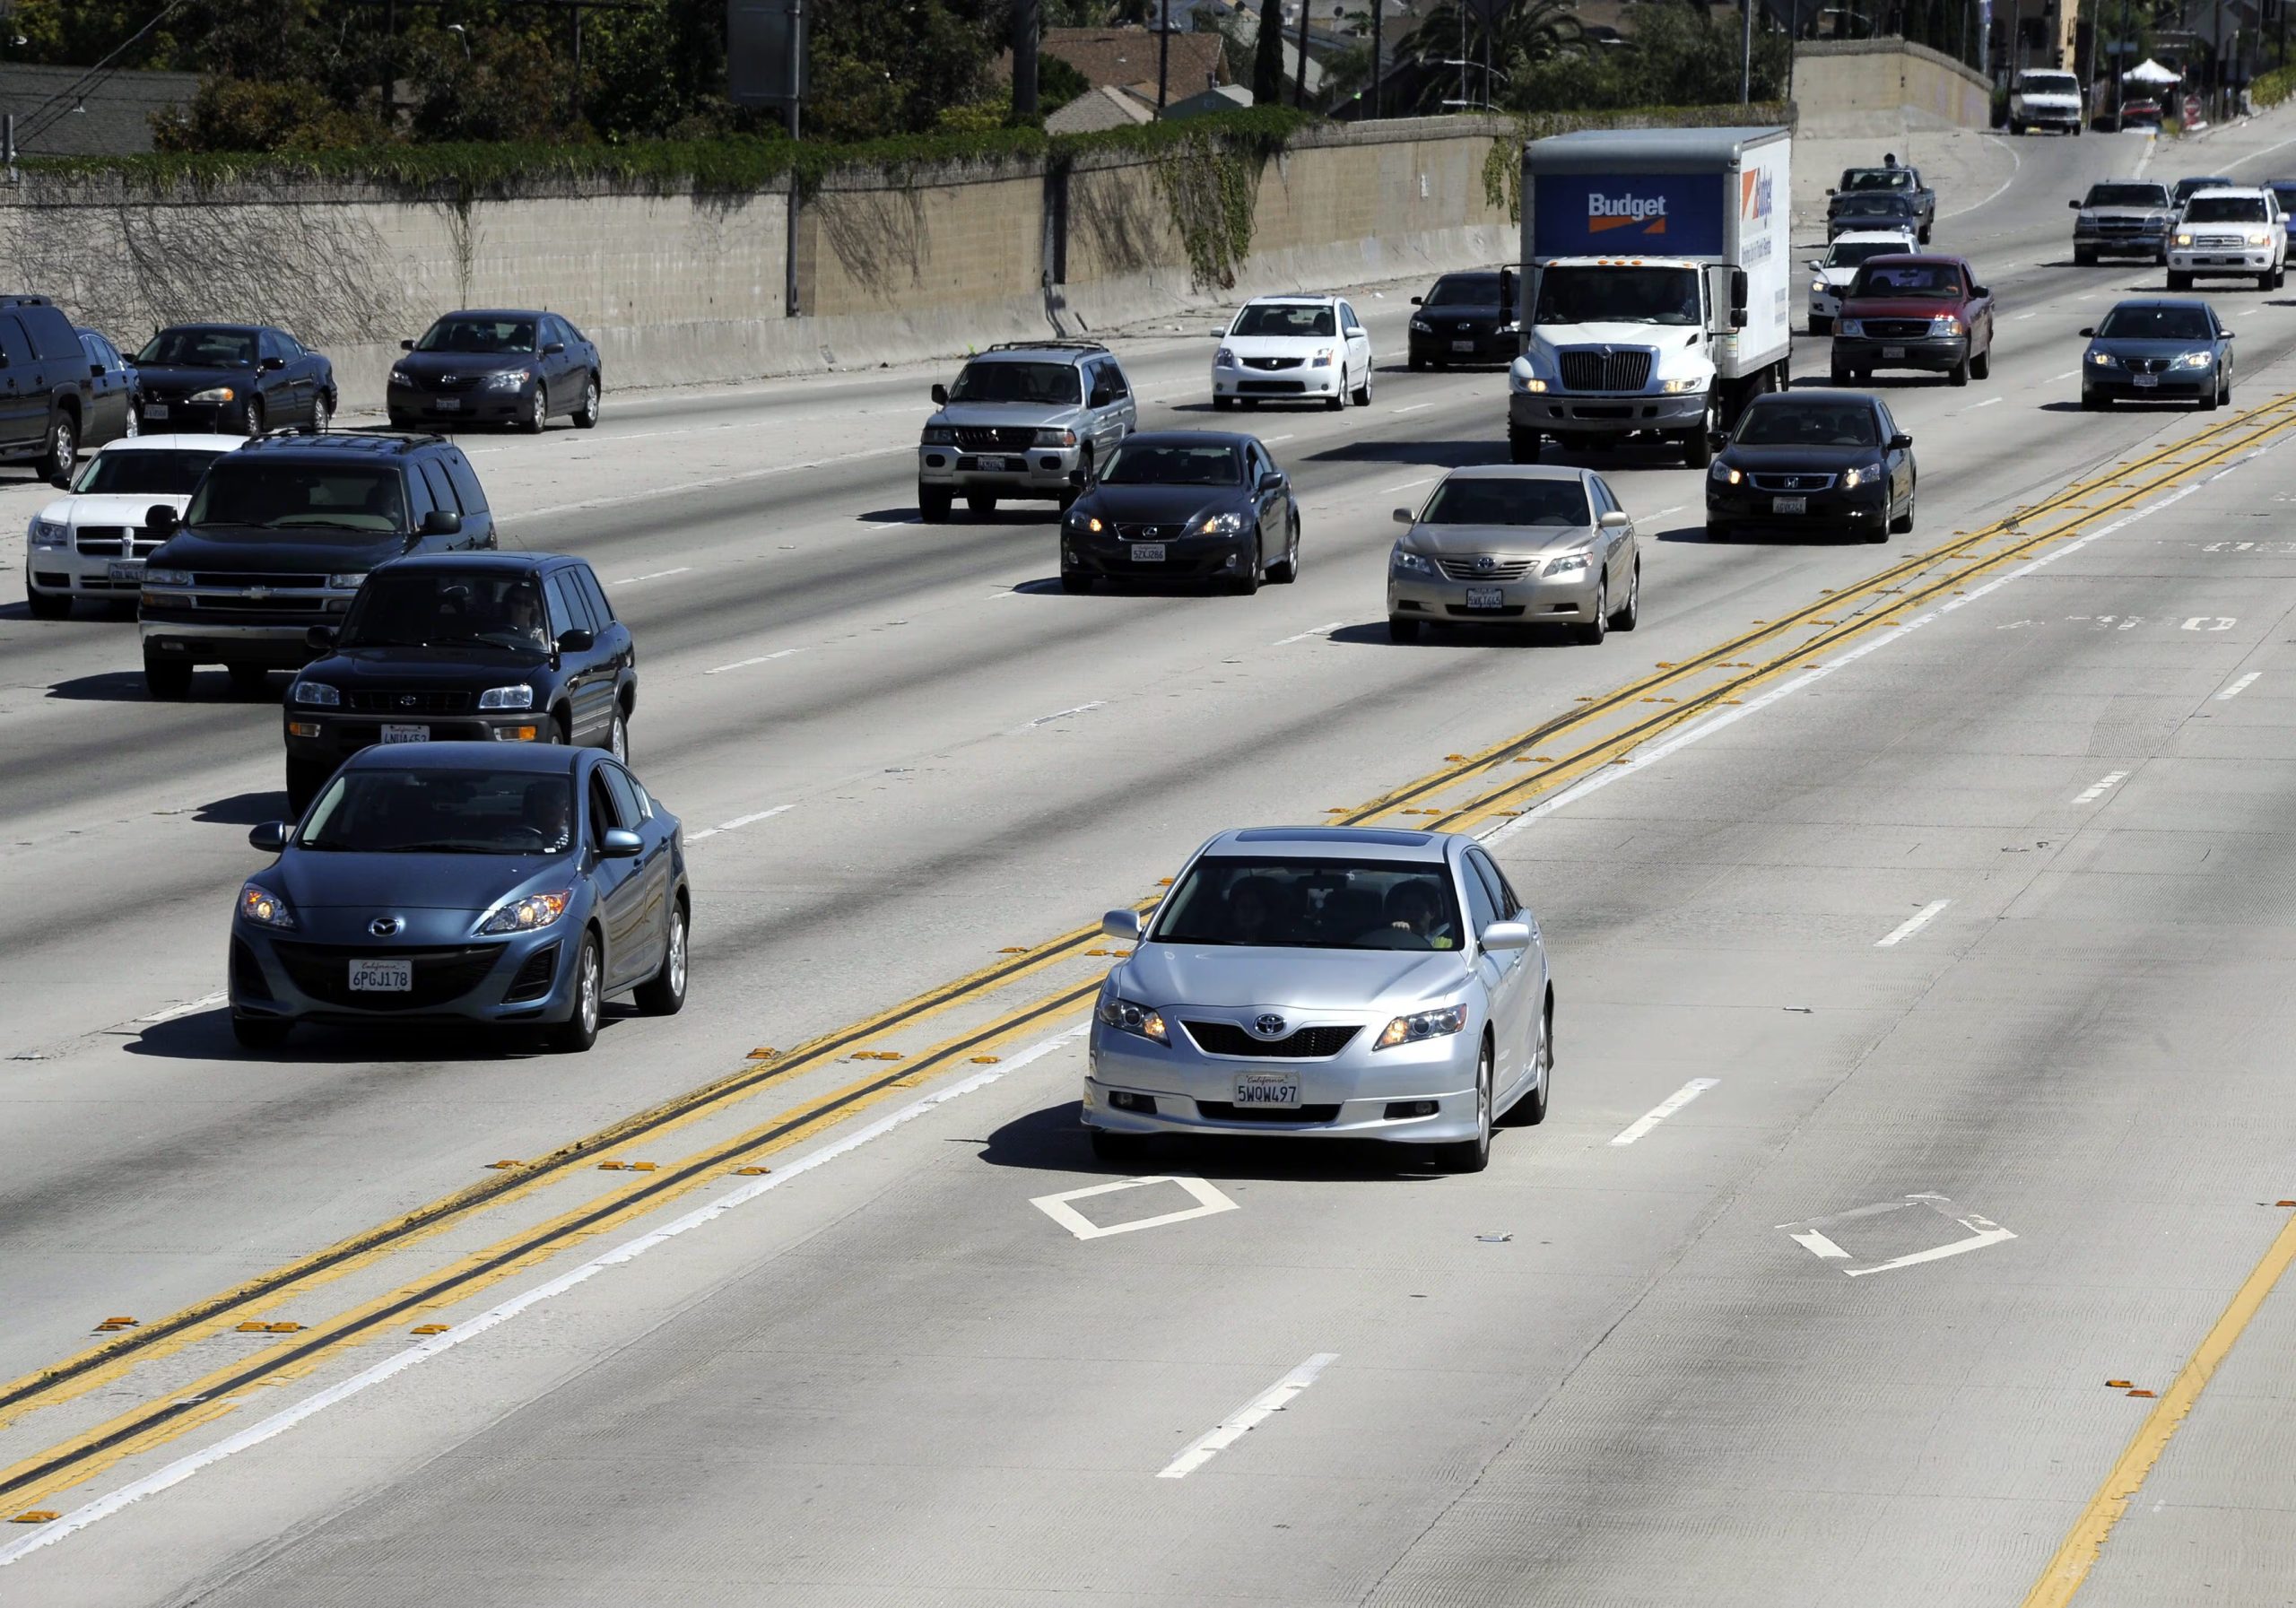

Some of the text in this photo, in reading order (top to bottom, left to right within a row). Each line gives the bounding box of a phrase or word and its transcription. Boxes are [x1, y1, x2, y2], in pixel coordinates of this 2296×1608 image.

[1588, 193, 1665, 222] Budget
[353, 971, 408, 987] 6PGJ178
[1247, 1075, 1288, 1086] California
[1238, 1085, 1297, 1103] 5WQW497
